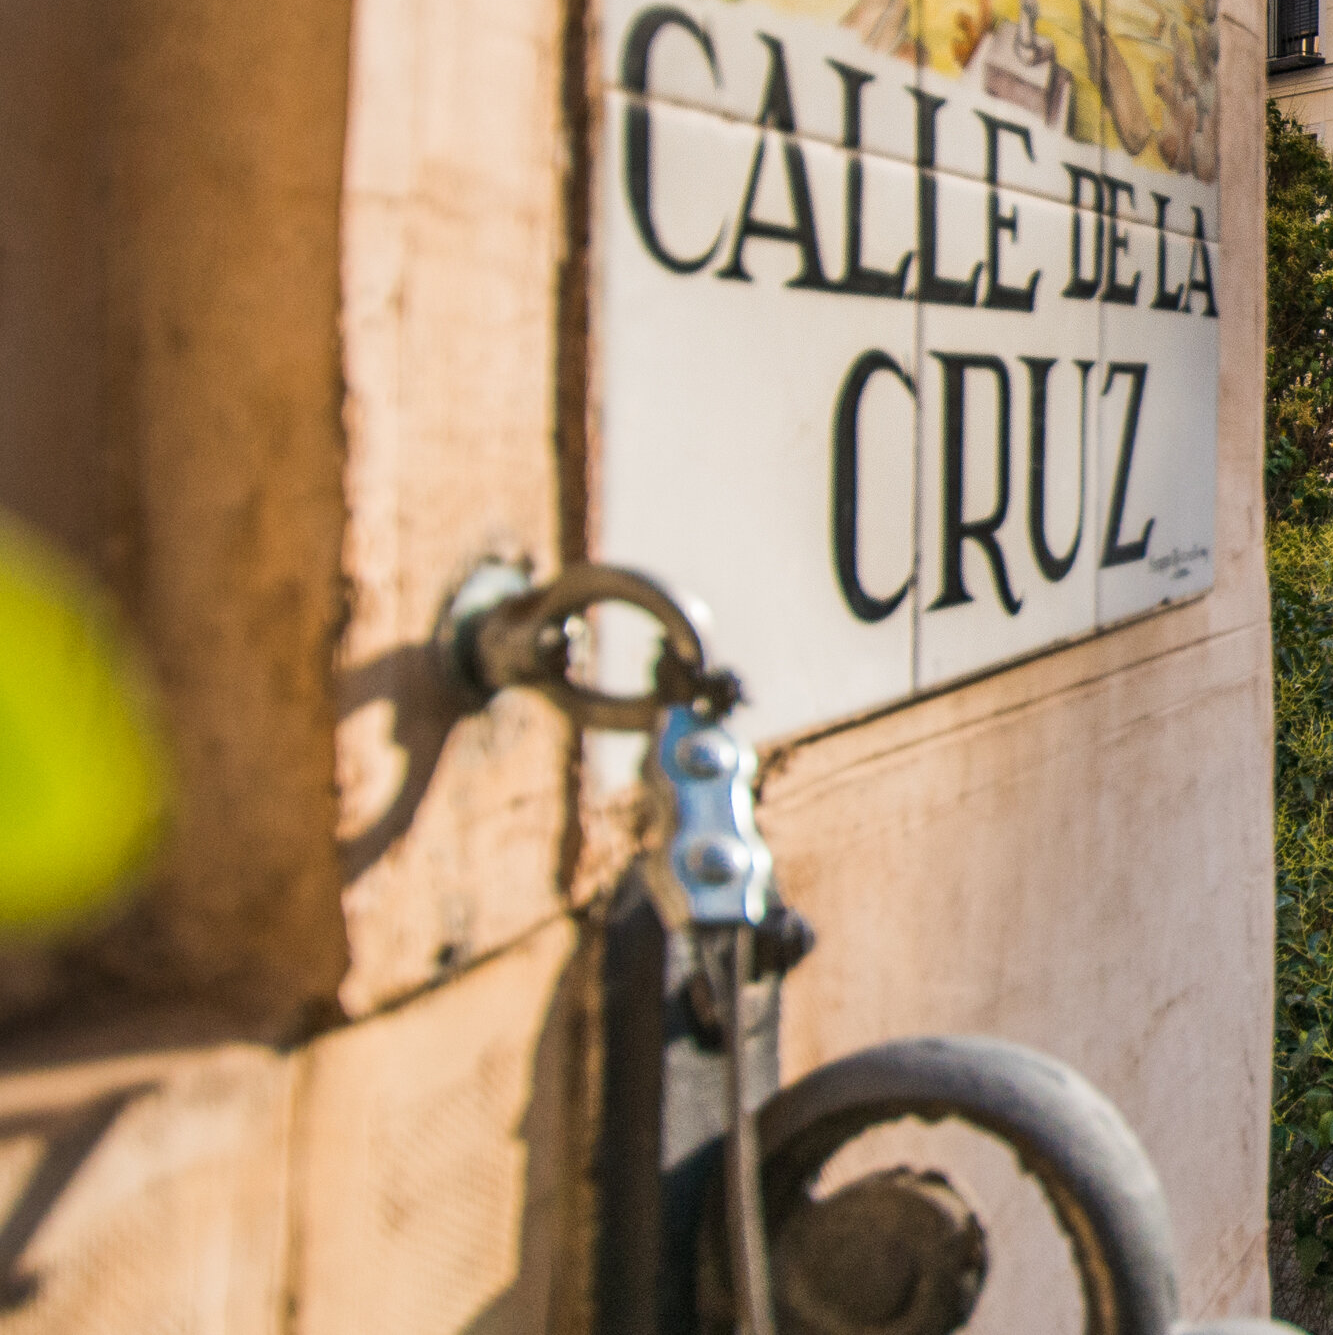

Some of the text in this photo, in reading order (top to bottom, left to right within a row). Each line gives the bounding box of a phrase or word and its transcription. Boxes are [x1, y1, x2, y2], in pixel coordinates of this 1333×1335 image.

[620, 5, 1220, 318] CALLE DE LA
[830, 348, 1156, 624] CRUZ
